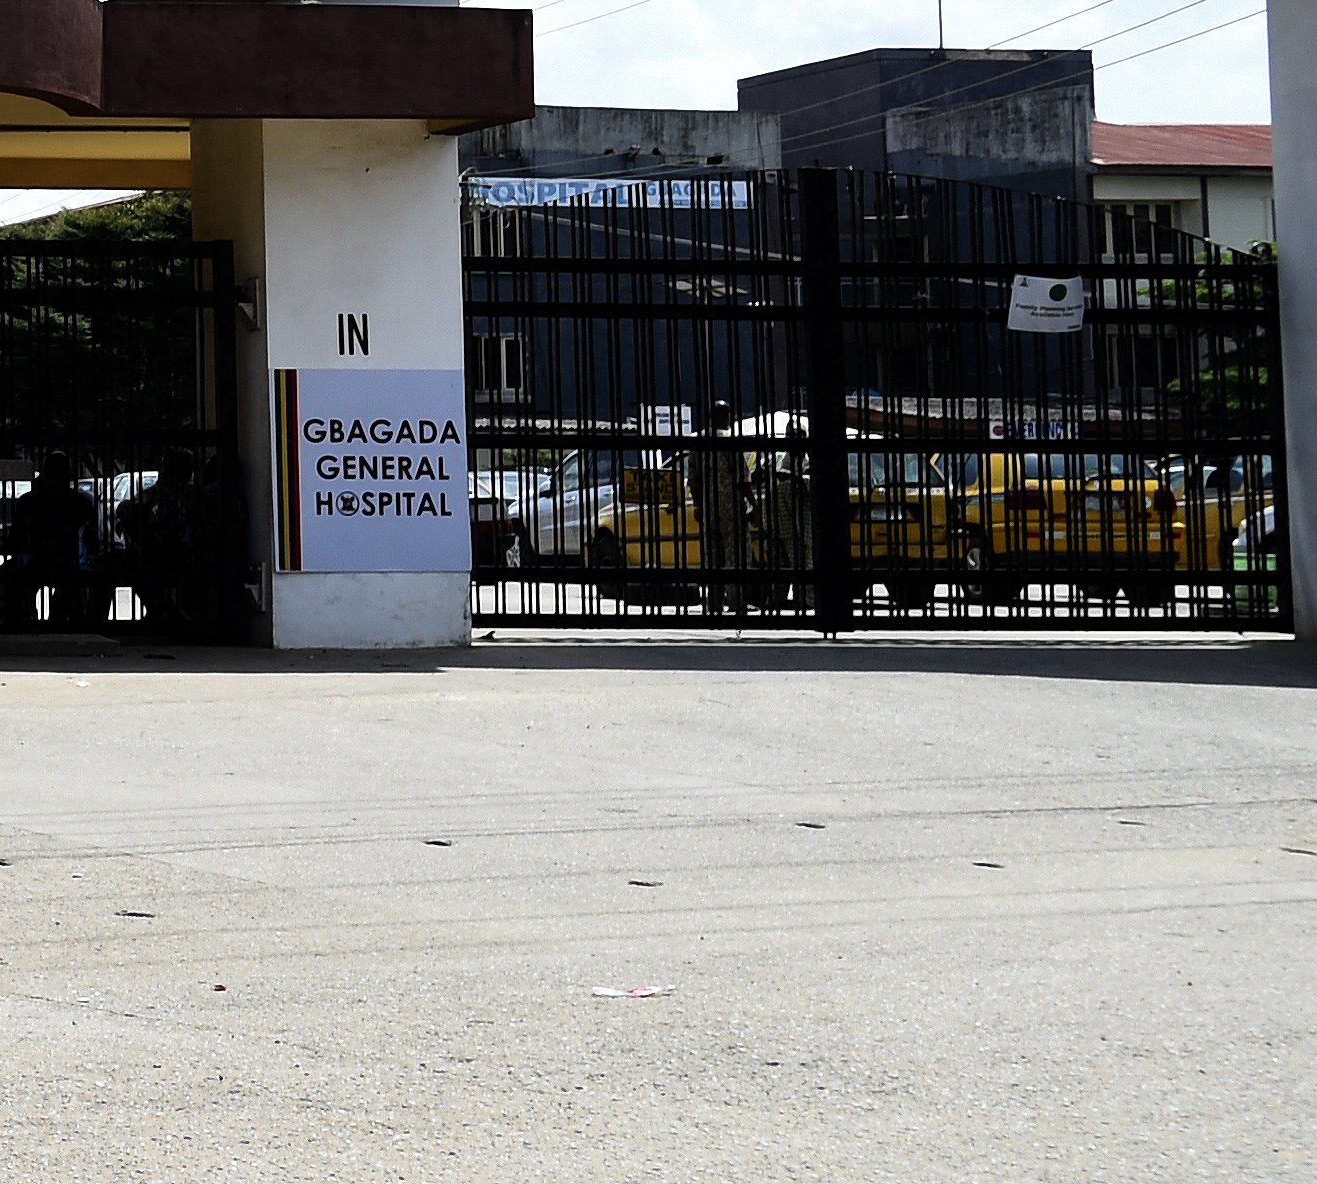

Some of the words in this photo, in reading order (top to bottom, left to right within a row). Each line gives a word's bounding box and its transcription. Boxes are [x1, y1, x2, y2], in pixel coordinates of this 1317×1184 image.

[337, 313, 369, 356] IN
[303, 418, 461, 444] GBAGADA
[316, 455, 450, 481] GENERAL
[315, 490, 453, 517] HOSPITAL
